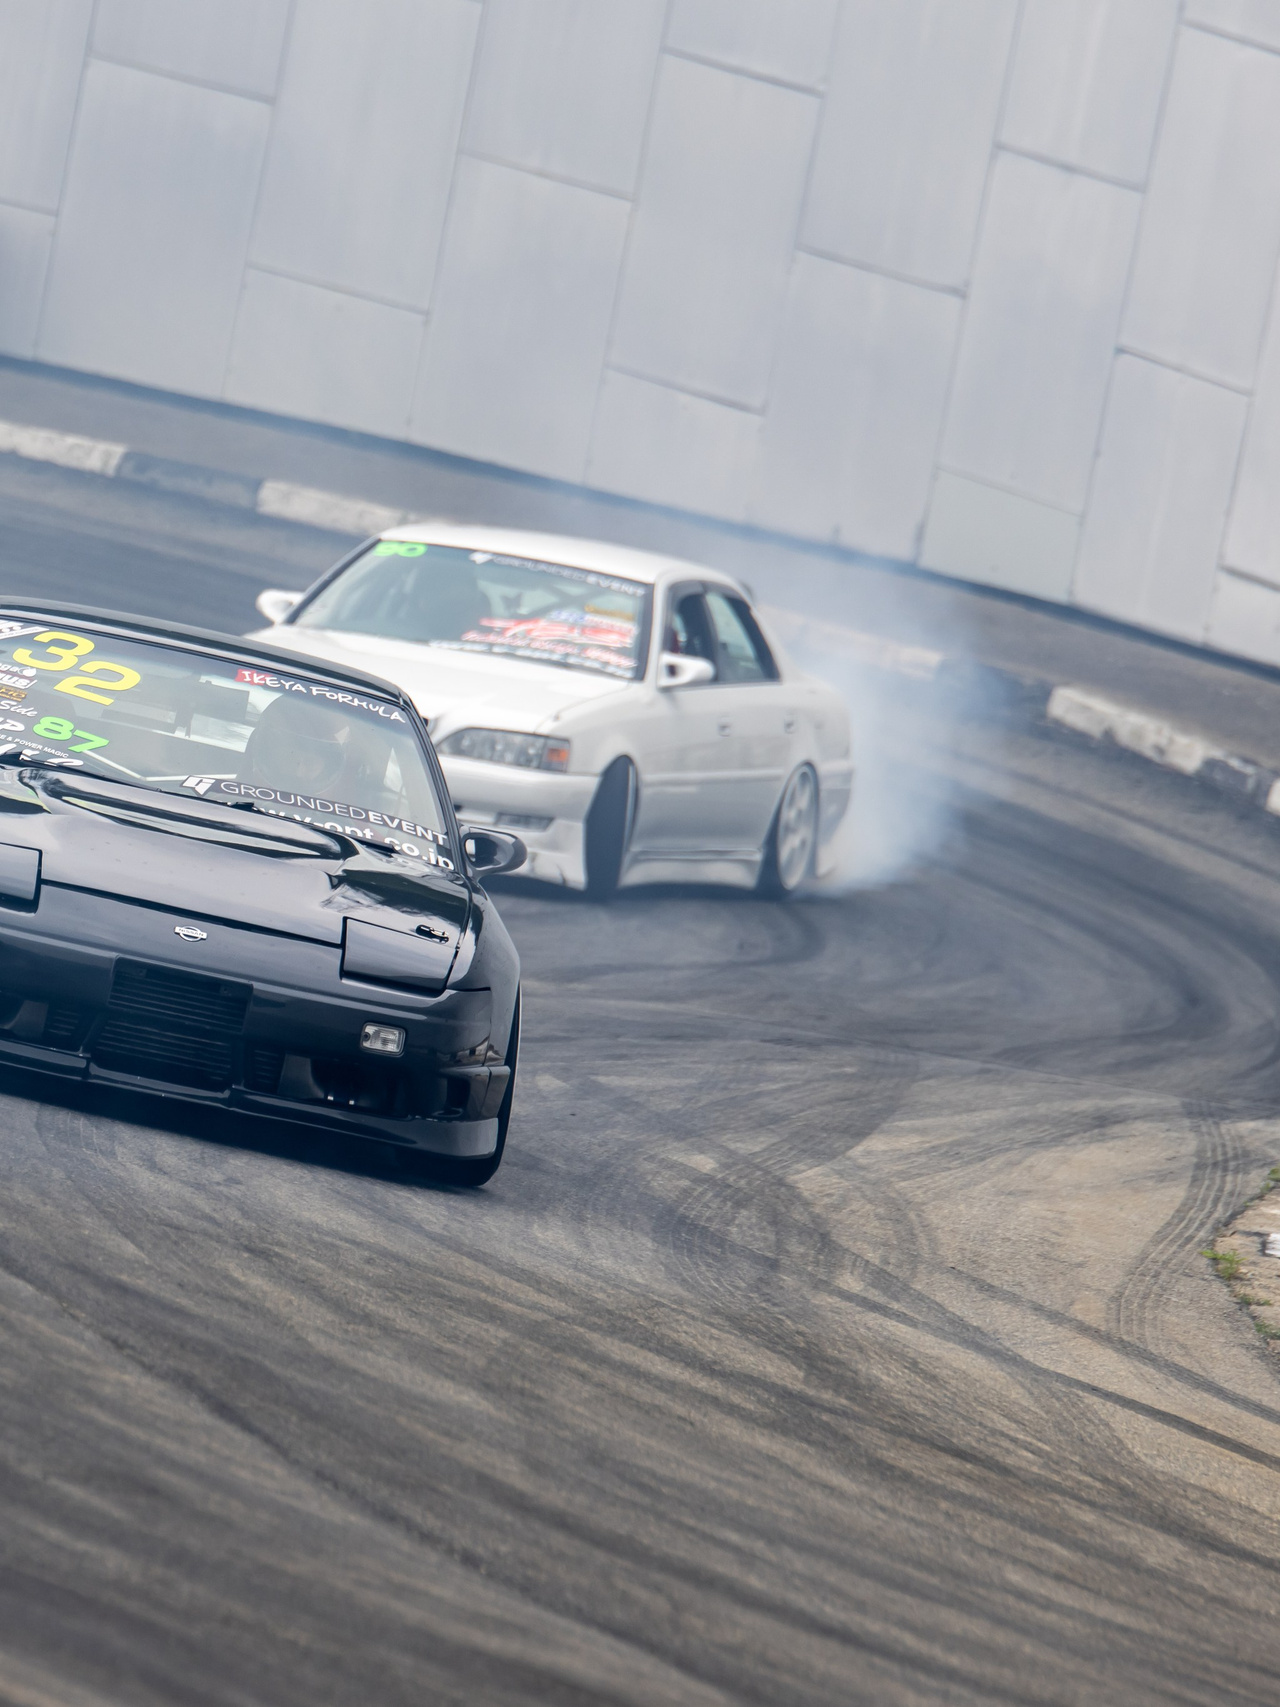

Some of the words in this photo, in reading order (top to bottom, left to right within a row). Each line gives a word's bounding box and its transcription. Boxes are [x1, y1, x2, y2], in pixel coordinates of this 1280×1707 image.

[13, 631, 141, 706] 32
[241, 670, 307, 694] IKEYA
[309, 686, 406, 724] FORMULA
[13, 738, 43, 751] POWER
[43, 745, 69, 759] MAGIC
[32, 716, 110, 753] 87
